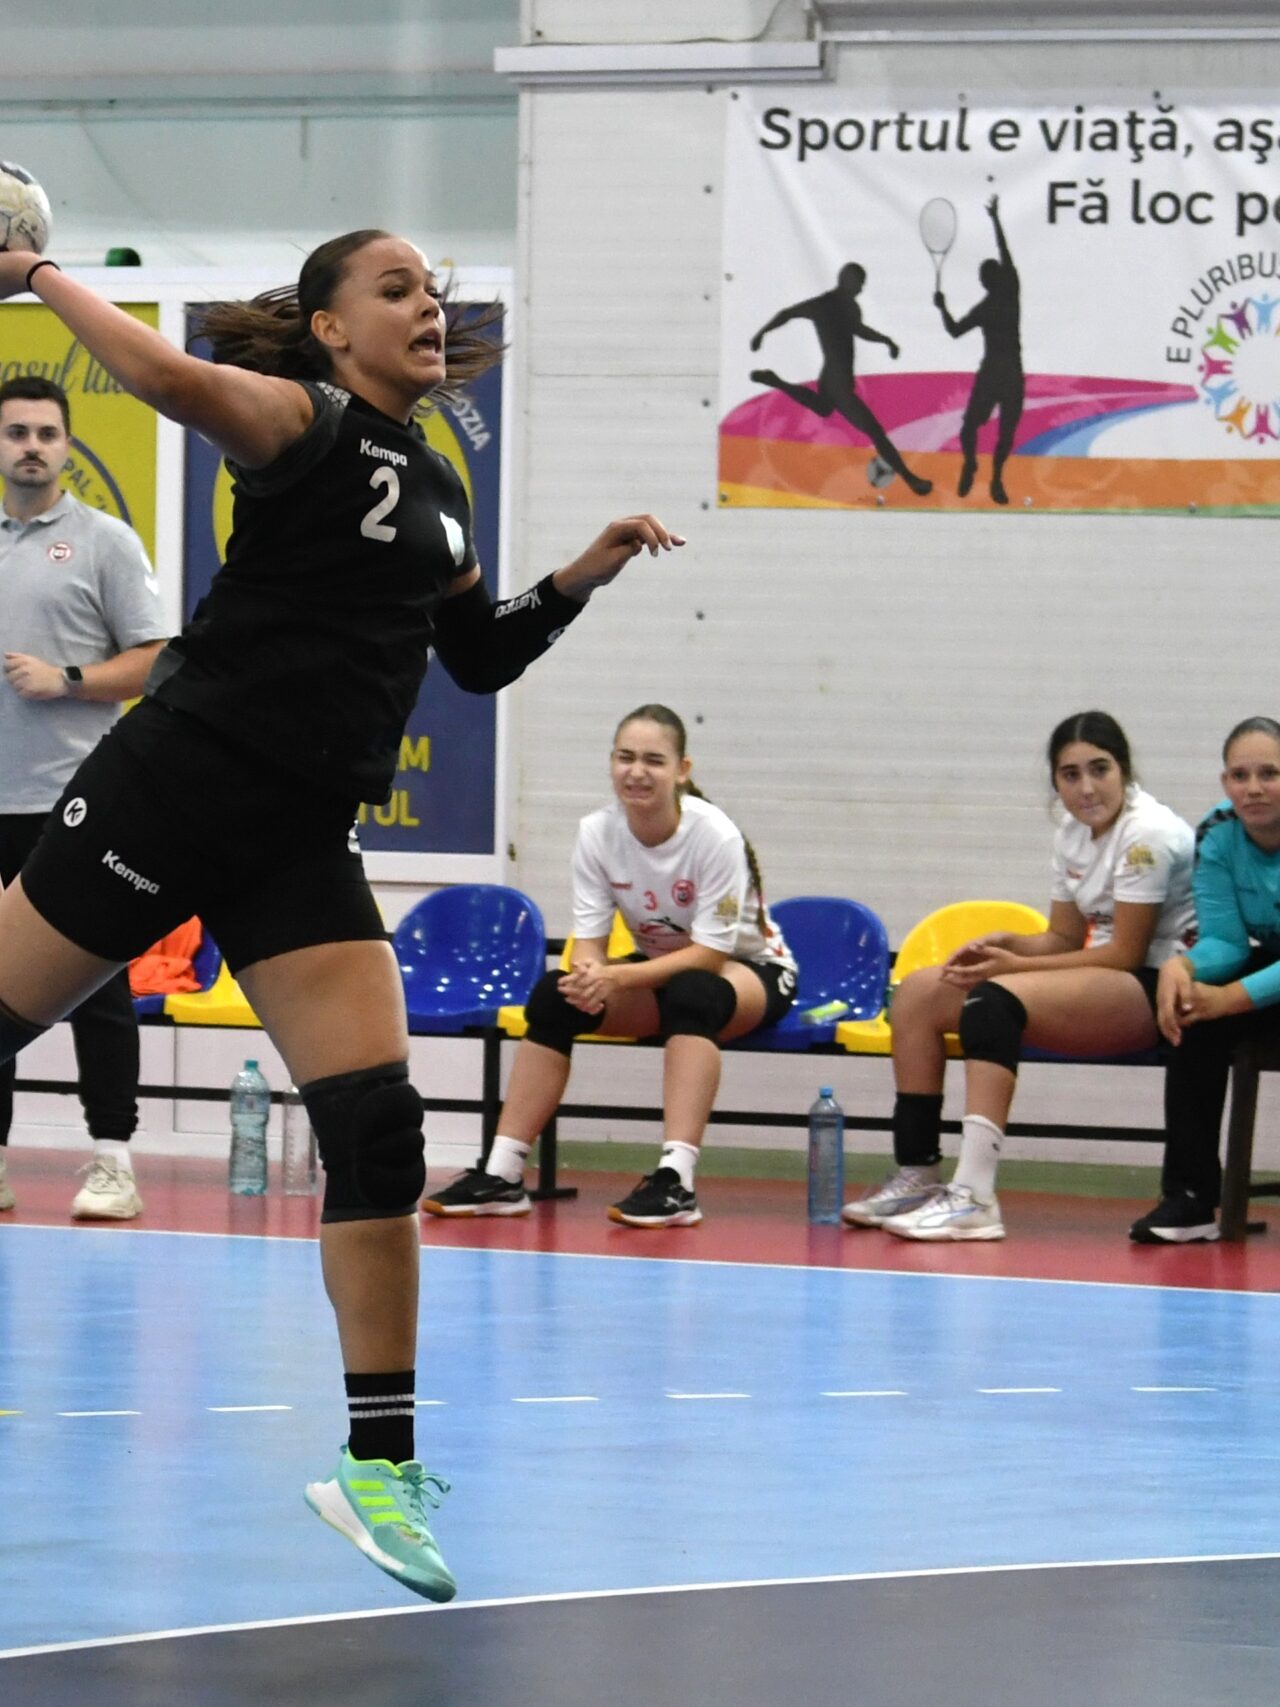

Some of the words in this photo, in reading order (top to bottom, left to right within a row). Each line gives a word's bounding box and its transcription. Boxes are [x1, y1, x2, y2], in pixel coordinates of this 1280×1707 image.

[759, 107, 971, 162] Sportul
[988, 119, 1020, 151] e
[1213, 118, 1280, 164] aş
[1047, 178, 1109, 225] Fă
[1131, 178, 1215, 225] loc
[1235, 191, 1280, 237] p
[1170, 251, 1280, 339] PLURIBU
[1166, 346, 1192, 363] E
[451, 398, 490, 451] OZIA
[360, 438, 408, 467] Kempa
[61, 458, 91, 497] PAL
[360, 466, 400, 543] 2
[398, 735, 431, 772] M
[101, 849, 160, 895] Kempa
[643, 890, 658, 911] 3
